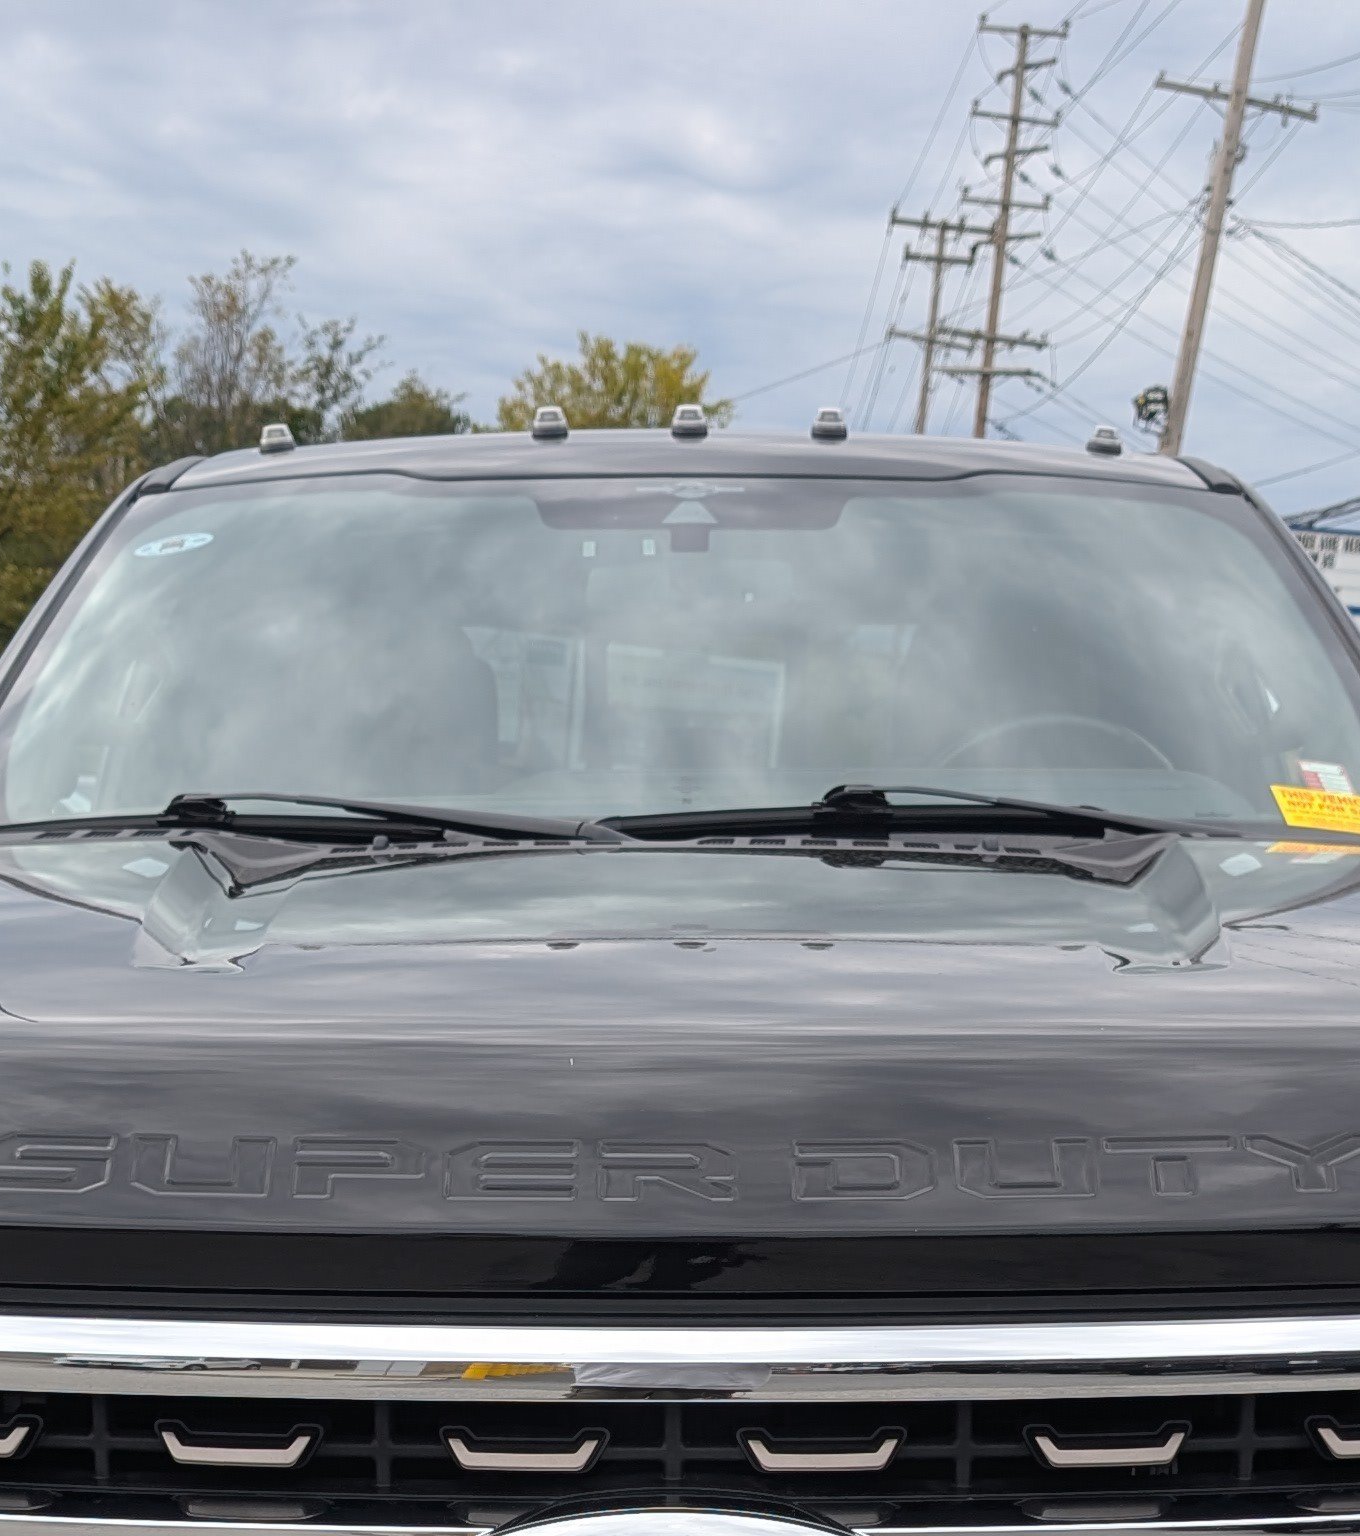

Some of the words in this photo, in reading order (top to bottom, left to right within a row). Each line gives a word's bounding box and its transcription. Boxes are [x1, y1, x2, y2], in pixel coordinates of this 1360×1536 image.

[1281, 789, 1315, 802] THIS
[1287, 800, 1313, 809] NOT
[1317, 803, 1345, 812] FOR
